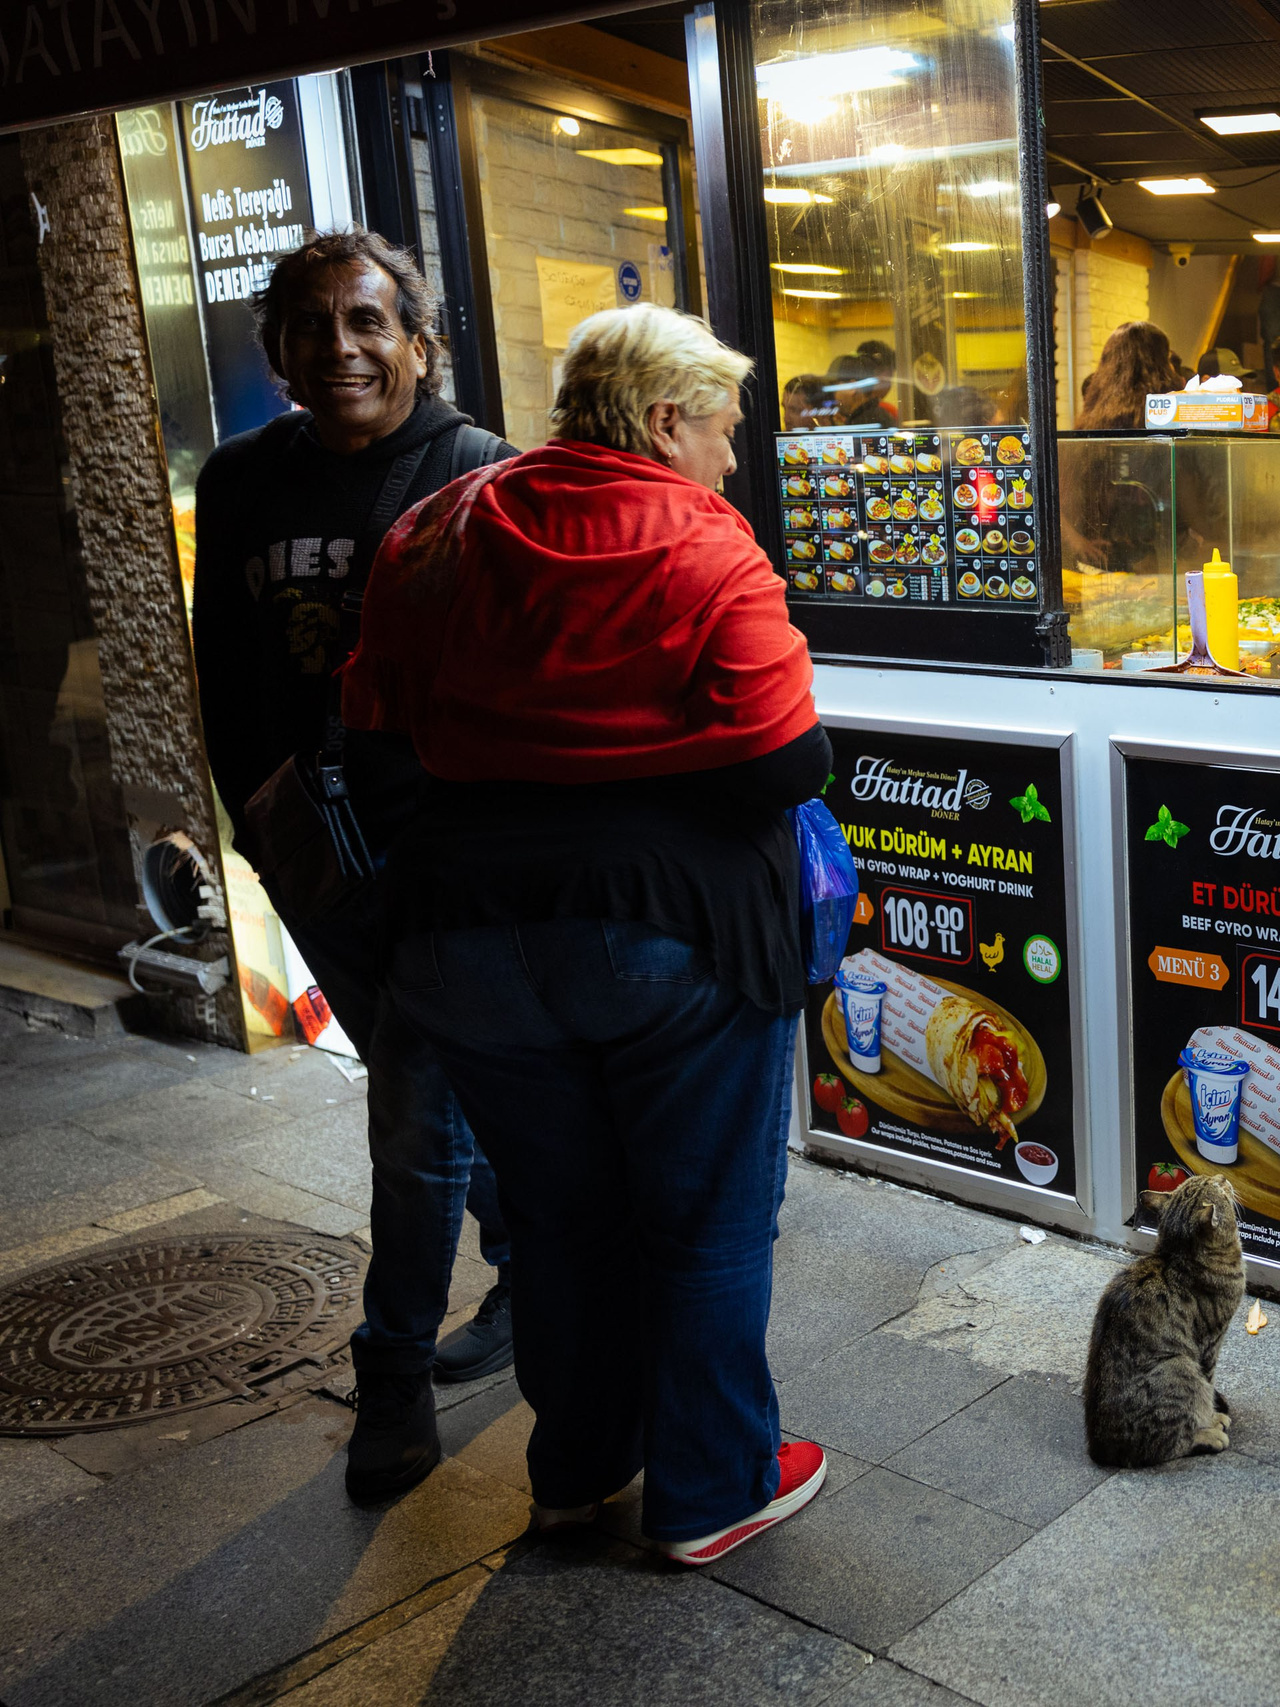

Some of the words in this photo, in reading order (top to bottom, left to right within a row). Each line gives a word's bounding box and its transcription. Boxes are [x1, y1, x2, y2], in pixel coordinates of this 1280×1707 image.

[191, 90, 266, 151] Hattad
[202, 188, 234, 223] Nefis
[233, 178, 292, 221] Tereyağlı
[199, 231, 235, 262] Bursa
[1149, 399, 1171, 409] one
[851, 755, 968, 812] Hattad
[931, 808, 960, 821] DÖNER
[840, 823, 876, 850] VUK
[881, 827, 946, 861] DÜRÜM
[967, 843, 1033, 874] AYRAN
[867, 859, 896, 875] GYRO
[898, 864, 930, 881] WRAP
[941, 871, 995, 892] YOGHURT
[998, 881, 1034, 898] DRINK
[1192, 881, 1217, 906] ET
[1182, 914, 1212, 932] BEEF
[1214, 918, 1252, 938] GYRO
[937, 928, 962, 956] TL
[1031, 955, 1053, 966] HALAL
[1031, 963, 1053, 974] HELAL
[1157, 954, 1205, 980] MENÜ
[1209, 963, 1220, 981] 3
[851, 1001, 874, 1025] İçim
[1201, 1084, 1231, 1109] İçim
[1200, 1112, 1232, 1127] Ayran
[1236, 1221, 1267, 1235] ürümümüz
[1253, 1232, 1274, 1245] include
